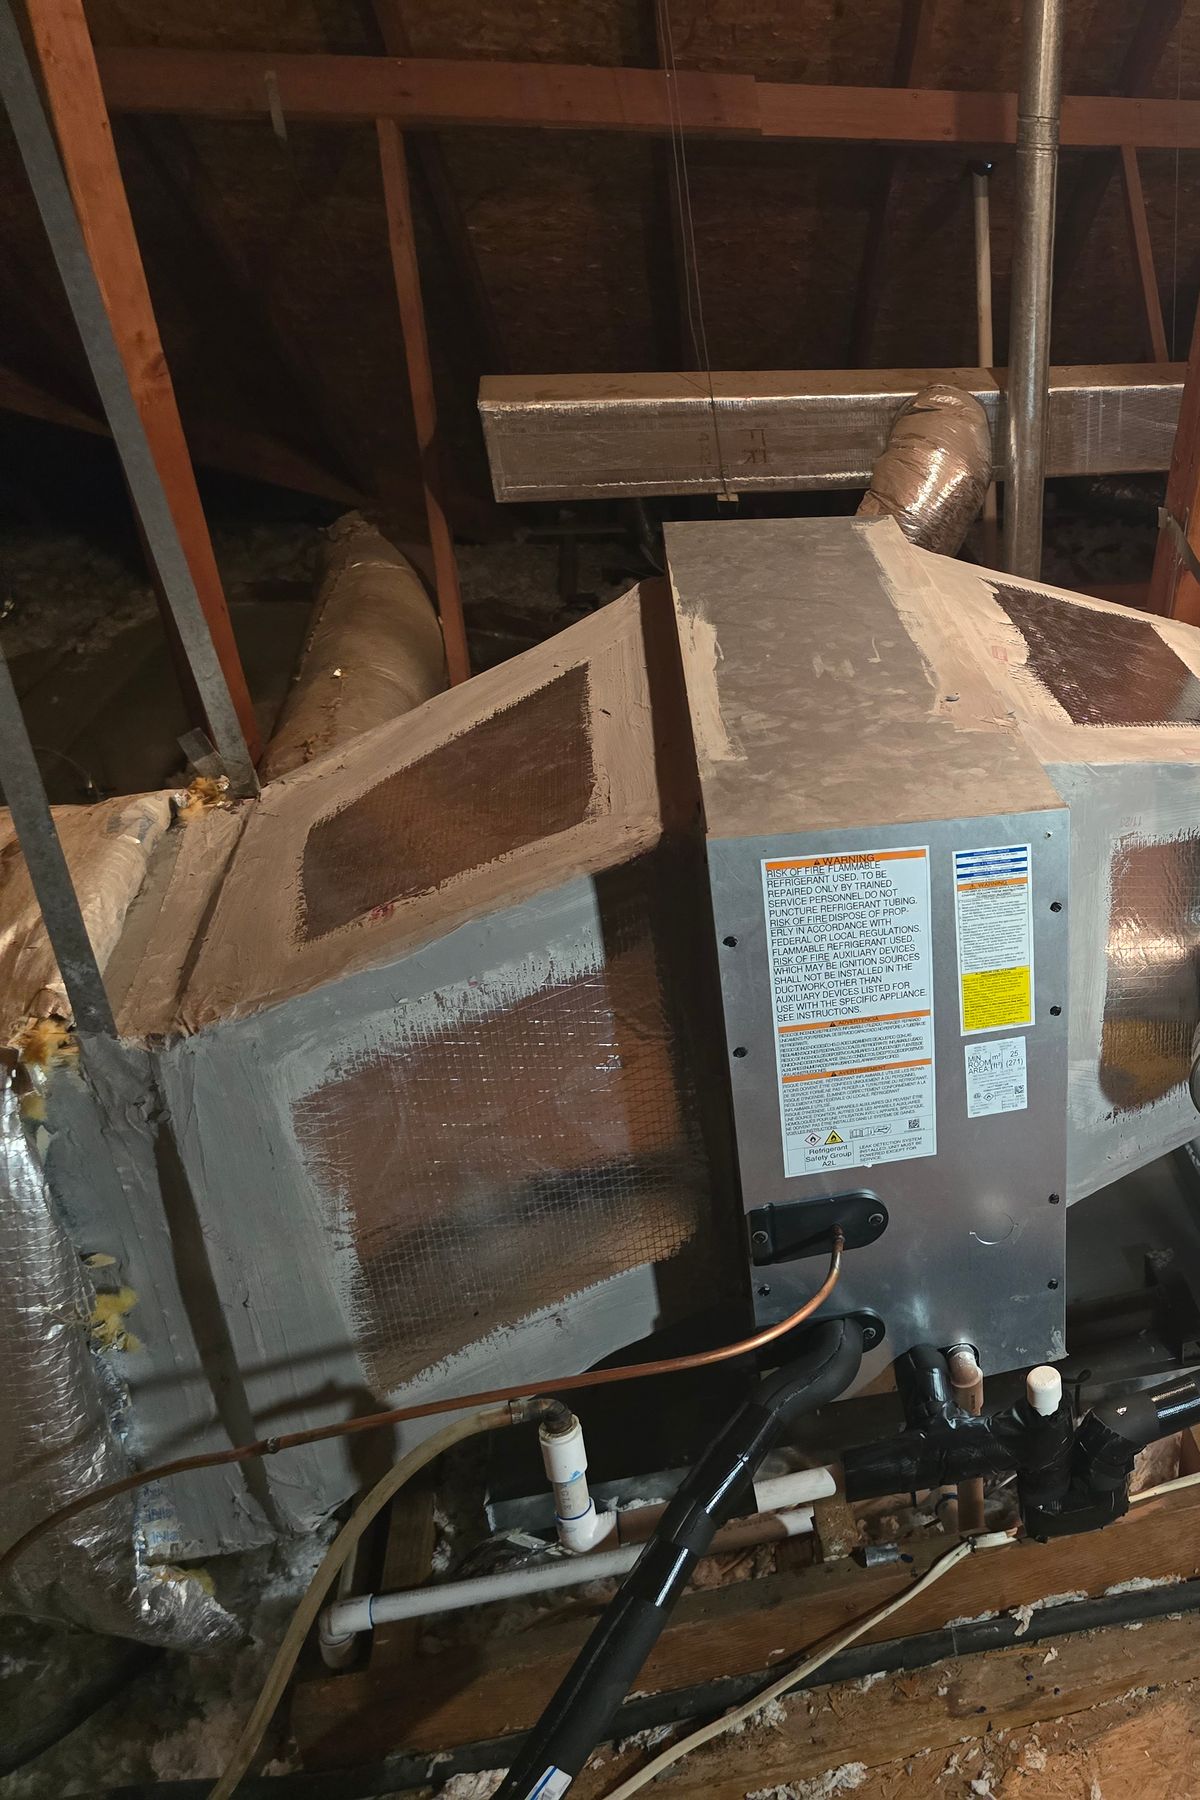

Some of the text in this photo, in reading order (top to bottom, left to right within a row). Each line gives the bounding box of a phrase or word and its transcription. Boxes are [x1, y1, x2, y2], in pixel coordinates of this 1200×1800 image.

[822, 854, 875, 865] WARNING
[767, 862, 880, 878] RISK OF FIRE FLAMMABLE
[767, 875, 830, 888] REFRIGERANT
[861, 872, 874, 880] TO
[876, 870, 887, 878] BE
[768, 880, 893, 898] REPAIRED ONLY BY TRAINED
[768, 898, 807, 908] SERVICE
[864, 890, 878, 900] DO
[880, 888, 898, 898] NOT
[769, 896, 918, 918] PUNCTURE REFRIGERANT TUBING.
[770, 906, 909, 928] RISK OF FIRE DISPOSE OF PROP-
[771, 918, 892, 938] ERLY IN ACCORDANCE WITH
[772, 924, 922, 947] FEDERAL OR LOCAL REGULATIONS.
[772, 944, 824, 956] FLAMMABLE
[826, 937, 888, 951] REFRIGERANT
[774, 944, 916, 966] RISK OF FIRE AUXILIARY DEVICES
[774, 952, 920, 976] WHICH MAY BE IGNITION SOURCES
[774, 962, 913, 985] SHALL NOT BE INSTALLED IN THE
[828, 979, 858, 988] OTHER
[860, 976, 882, 984] THAN
[776, 982, 910, 1004] AUXILIARY DEVICES LISTED FOR
[776, 1004, 794, 1014] USE
[796, 1000, 818, 1010] WITH
[820, 999, 837, 1008] THE
[840, 994, 878, 1006] SPECIFIC
[777, 1006, 862, 1022] SEE INSTRUCTIONS.
[968, 1060, 991, 1068] ROOM
[1006, 1058, 1024, 1068] (271)
[1010, 1050, 1019, 1058] 25
[968, 1066, 989, 1074] AREA
[808, 1144, 848, 1156] Refrigerant
[873, 1140, 901, 1148] DETECTION
[901, 1136, 922, 1144] SYSTEM
[806, 1151, 852, 1164] Safety Group
[886, 1148, 905, 1156] EXCEPT
[822, 1160, 836, 1168] A2L
